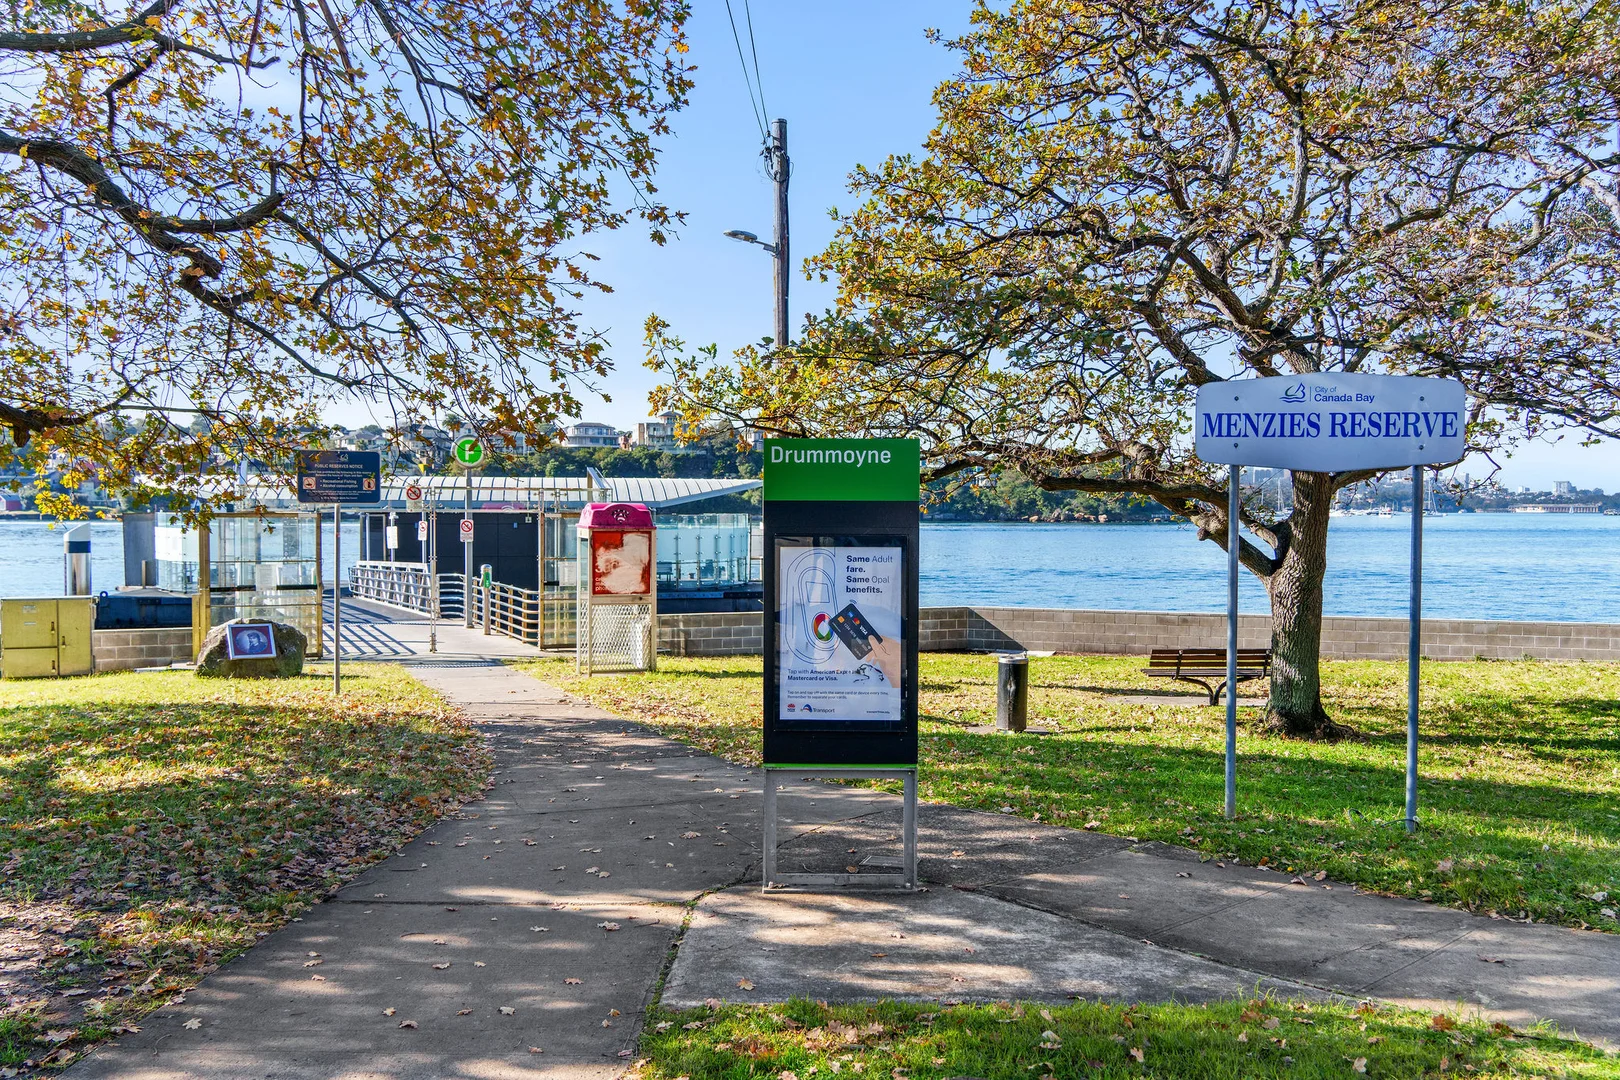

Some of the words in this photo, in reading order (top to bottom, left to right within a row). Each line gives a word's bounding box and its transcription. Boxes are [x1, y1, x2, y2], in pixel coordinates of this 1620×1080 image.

[1314, 386, 1328, 394] City
[1314, 393, 1353, 402] Canada
[1355, 393, 1375, 404] Bay
[1202, 412, 1321, 438] MENZIES
[1328, 411, 1458, 438] RESERVE
[771, 446, 892, 468] Drummoyne
[846, 555, 870, 563] Same
[871, 555, 893, 563] Adult
[846, 565, 866, 573] fare.
[846, 575, 870, 584] Same
[871, 575, 890, 585] Opal
[845, 585, 883, 594] benefits.
